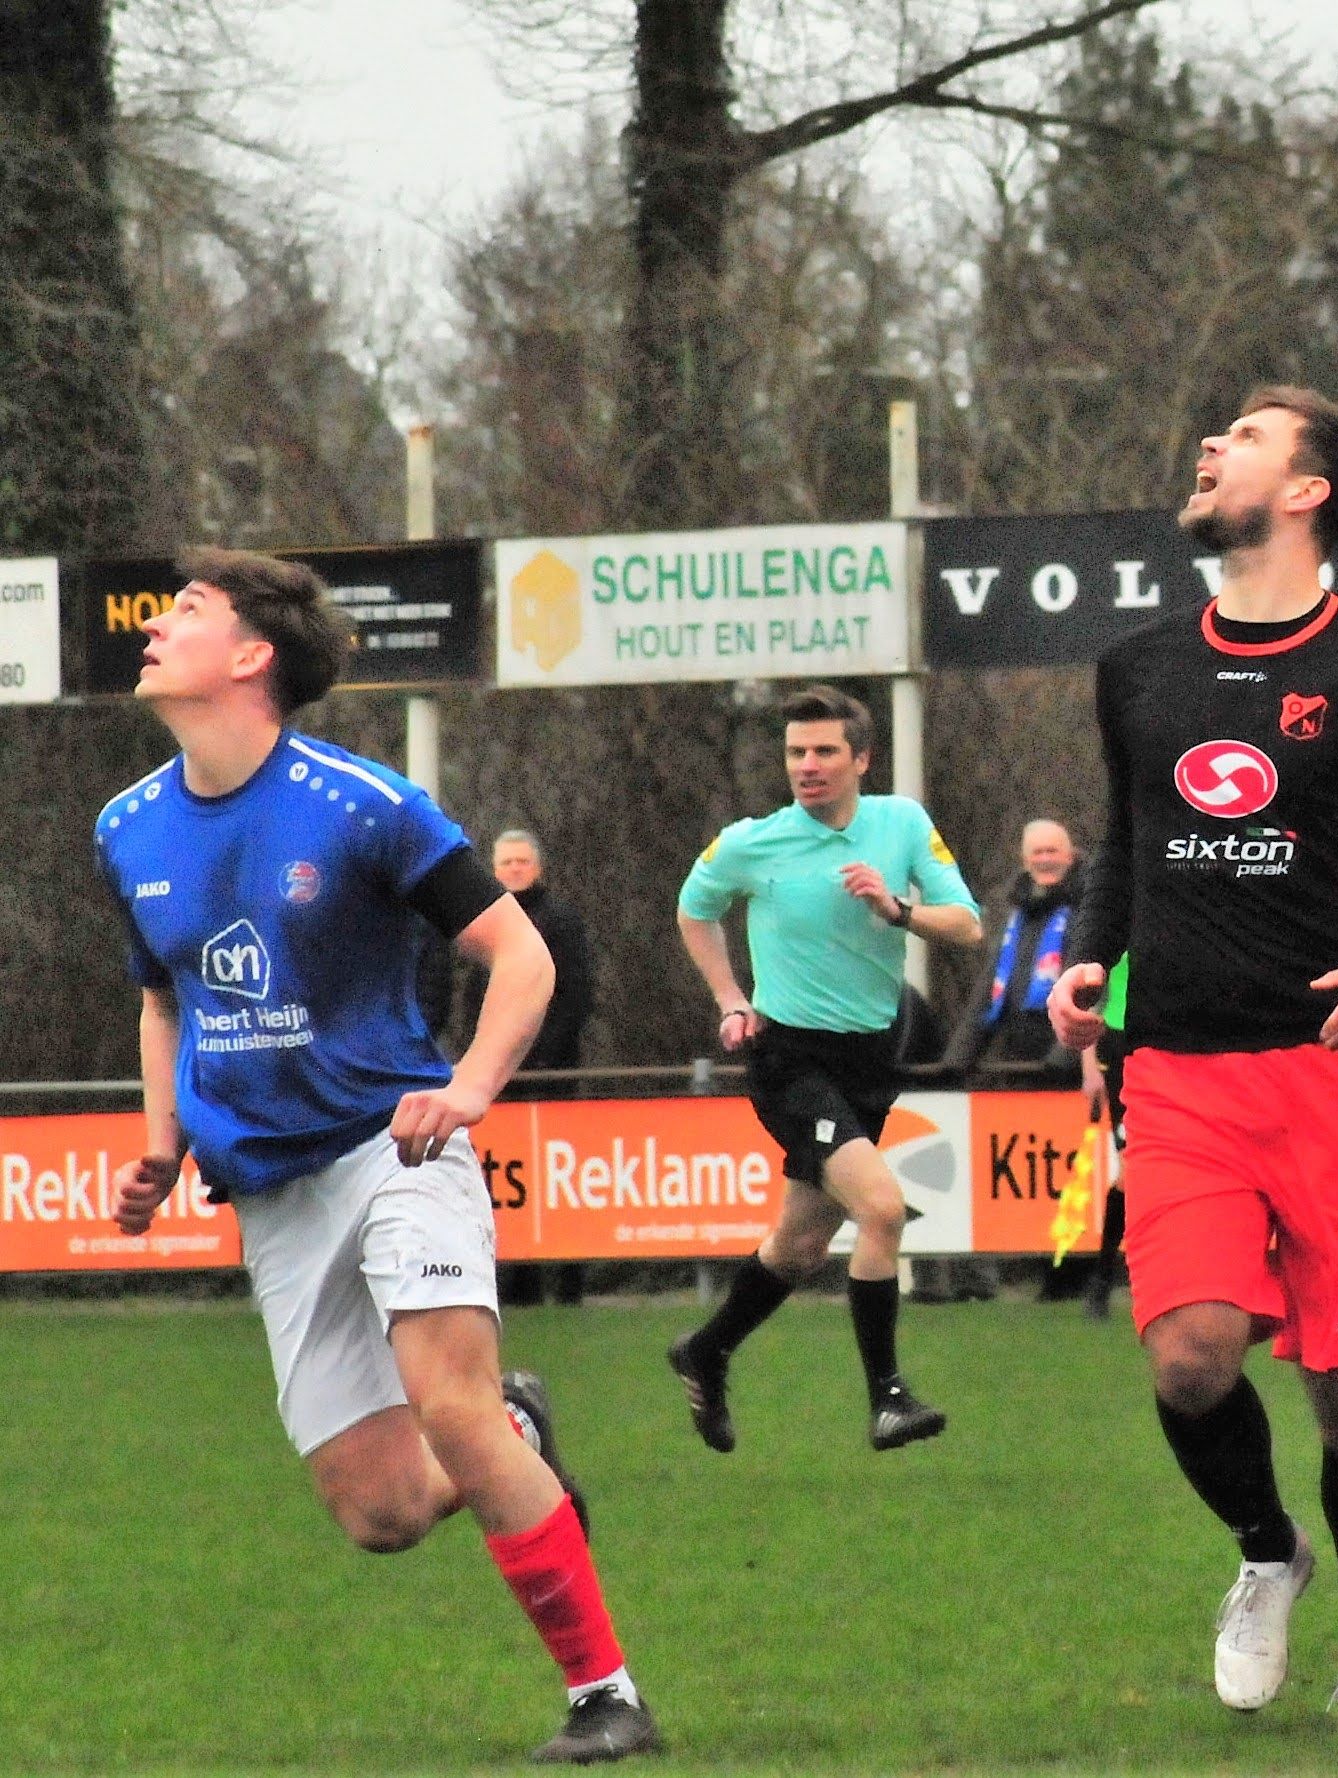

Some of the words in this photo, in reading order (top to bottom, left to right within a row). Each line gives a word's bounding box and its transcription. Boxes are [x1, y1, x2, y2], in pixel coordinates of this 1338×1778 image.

[592, 545, 892, 604] SCHUILENGA
[615, 623, 704, 660] HOUT
[713, 620, 757, 657] EN
[768, 616, 872, 655] PLAAT
[1216, 671, 1255, 682] CRAFT
[1165, 834, 1295, 861] sixton
[1236, 861, 1290, 878] peak
[136, 880, 170, 898] JAKO
[545, 1136, 771, 1209] Reklame
[420, 1263, 463, 1278] JAKO
